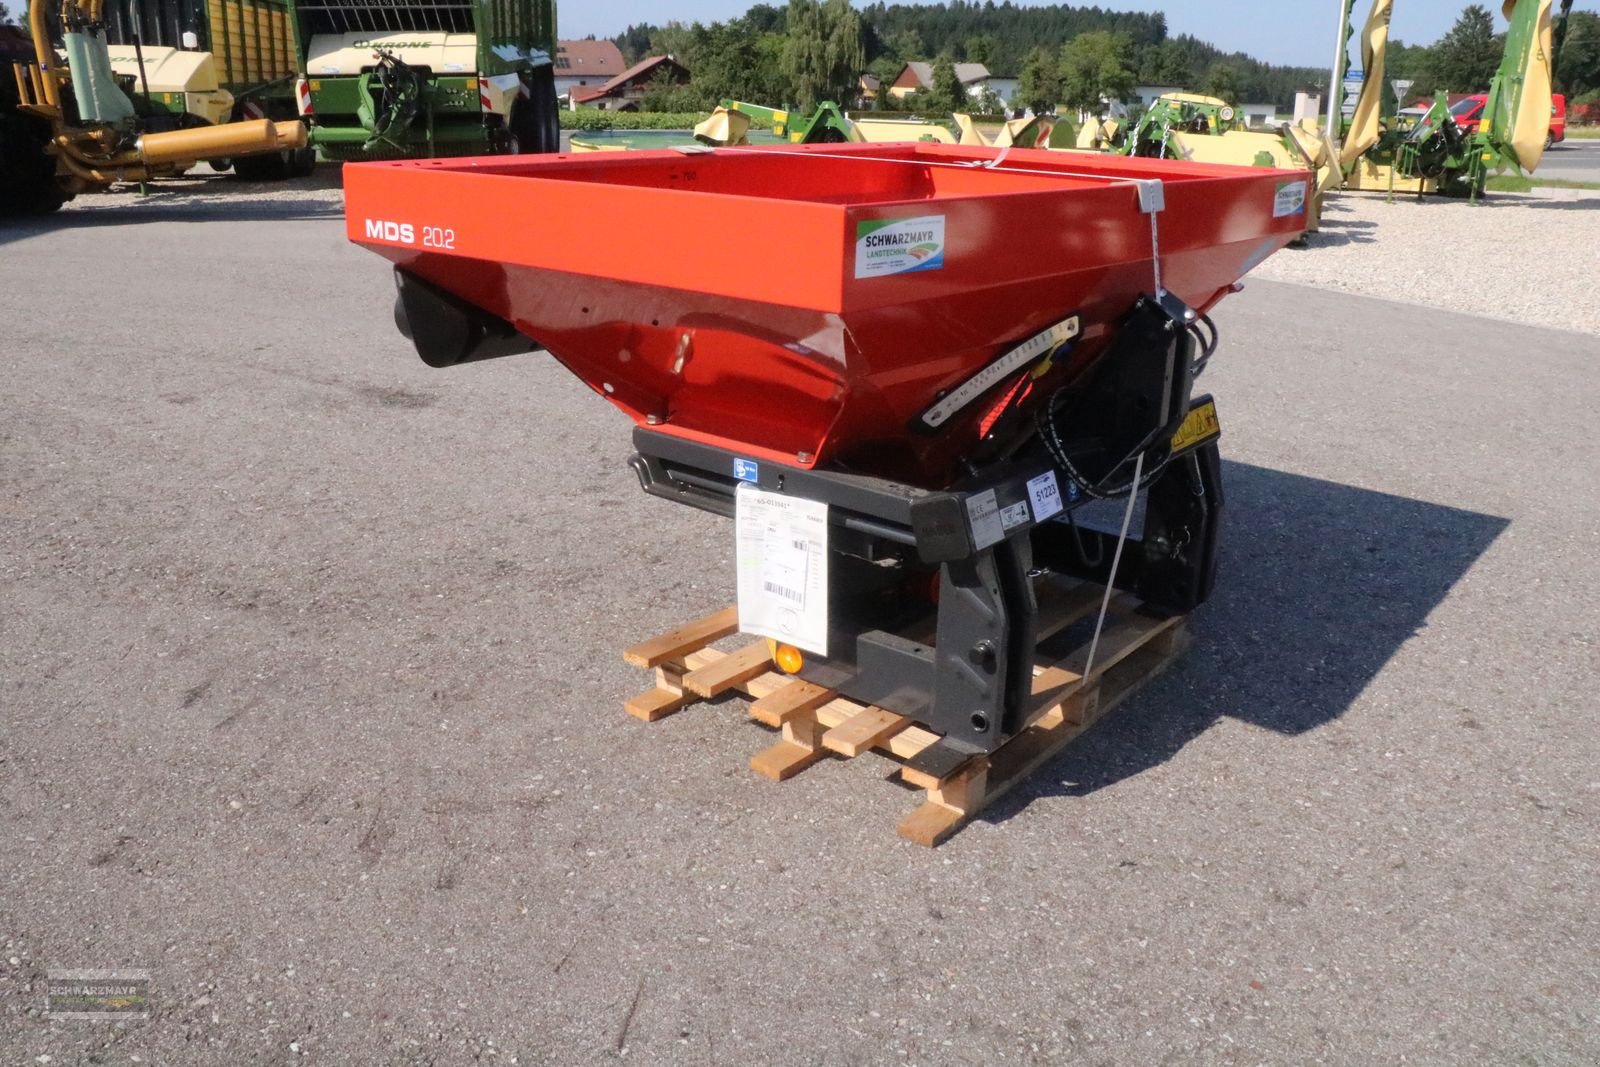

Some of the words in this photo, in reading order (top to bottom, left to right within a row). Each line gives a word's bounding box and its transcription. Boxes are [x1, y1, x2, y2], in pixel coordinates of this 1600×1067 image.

[365, 218, 415, 243] MDS
[423, 226, 455, 249] 20.2
[866, 230, 934, 247] SCHWARZMAYR
[866, 248, 907, 258] LANDTECHNIK
[1036, 484, 1056, 502] 51223
